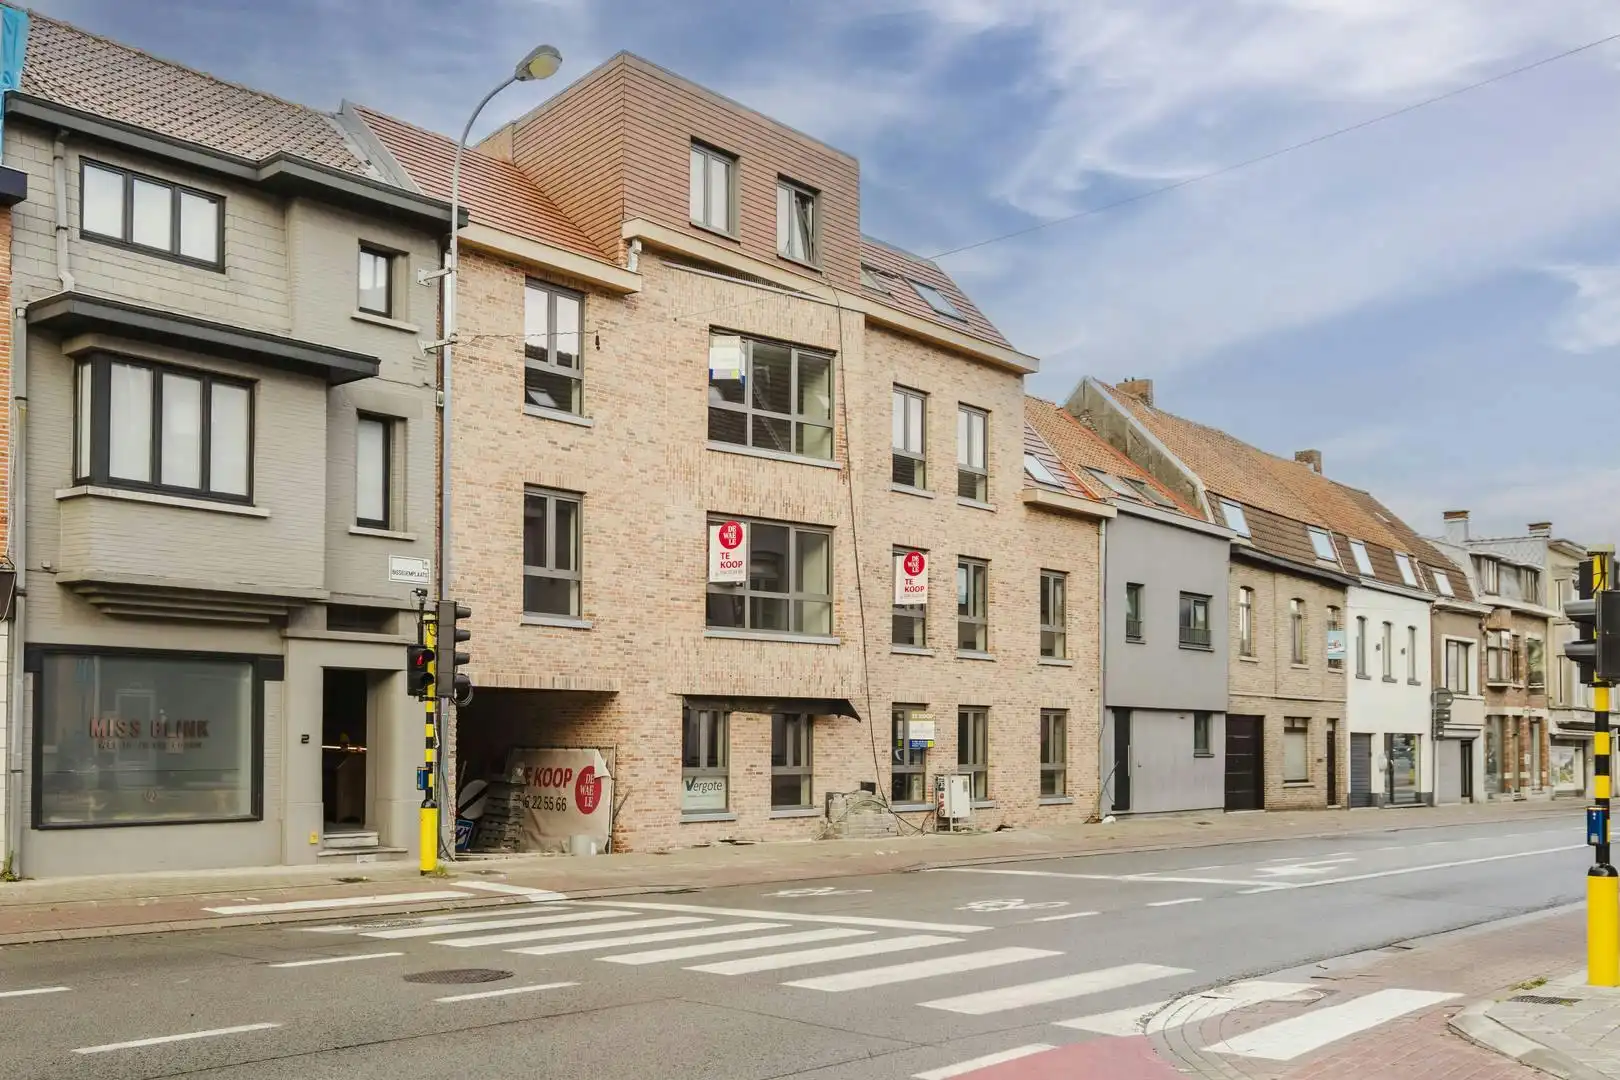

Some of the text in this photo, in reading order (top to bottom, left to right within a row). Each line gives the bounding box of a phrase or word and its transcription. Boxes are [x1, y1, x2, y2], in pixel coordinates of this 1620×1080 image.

[720, 552, 730, 560] TE
[90, 719, 210, 738] MISS BLINK
[301, 734, 309, 744] 2
[534, 767, 573, 788] KOOP
[585, 774, 595, 784] DE
[685, 776, 722, 793] Vergote
[580, 785, 594, 796] WAE
[531, 795, 542, 809] 22
[544, 796, 554, 810] 55
[556, 797, 567, 811] 66
[584, 796, 593, 807] LE
